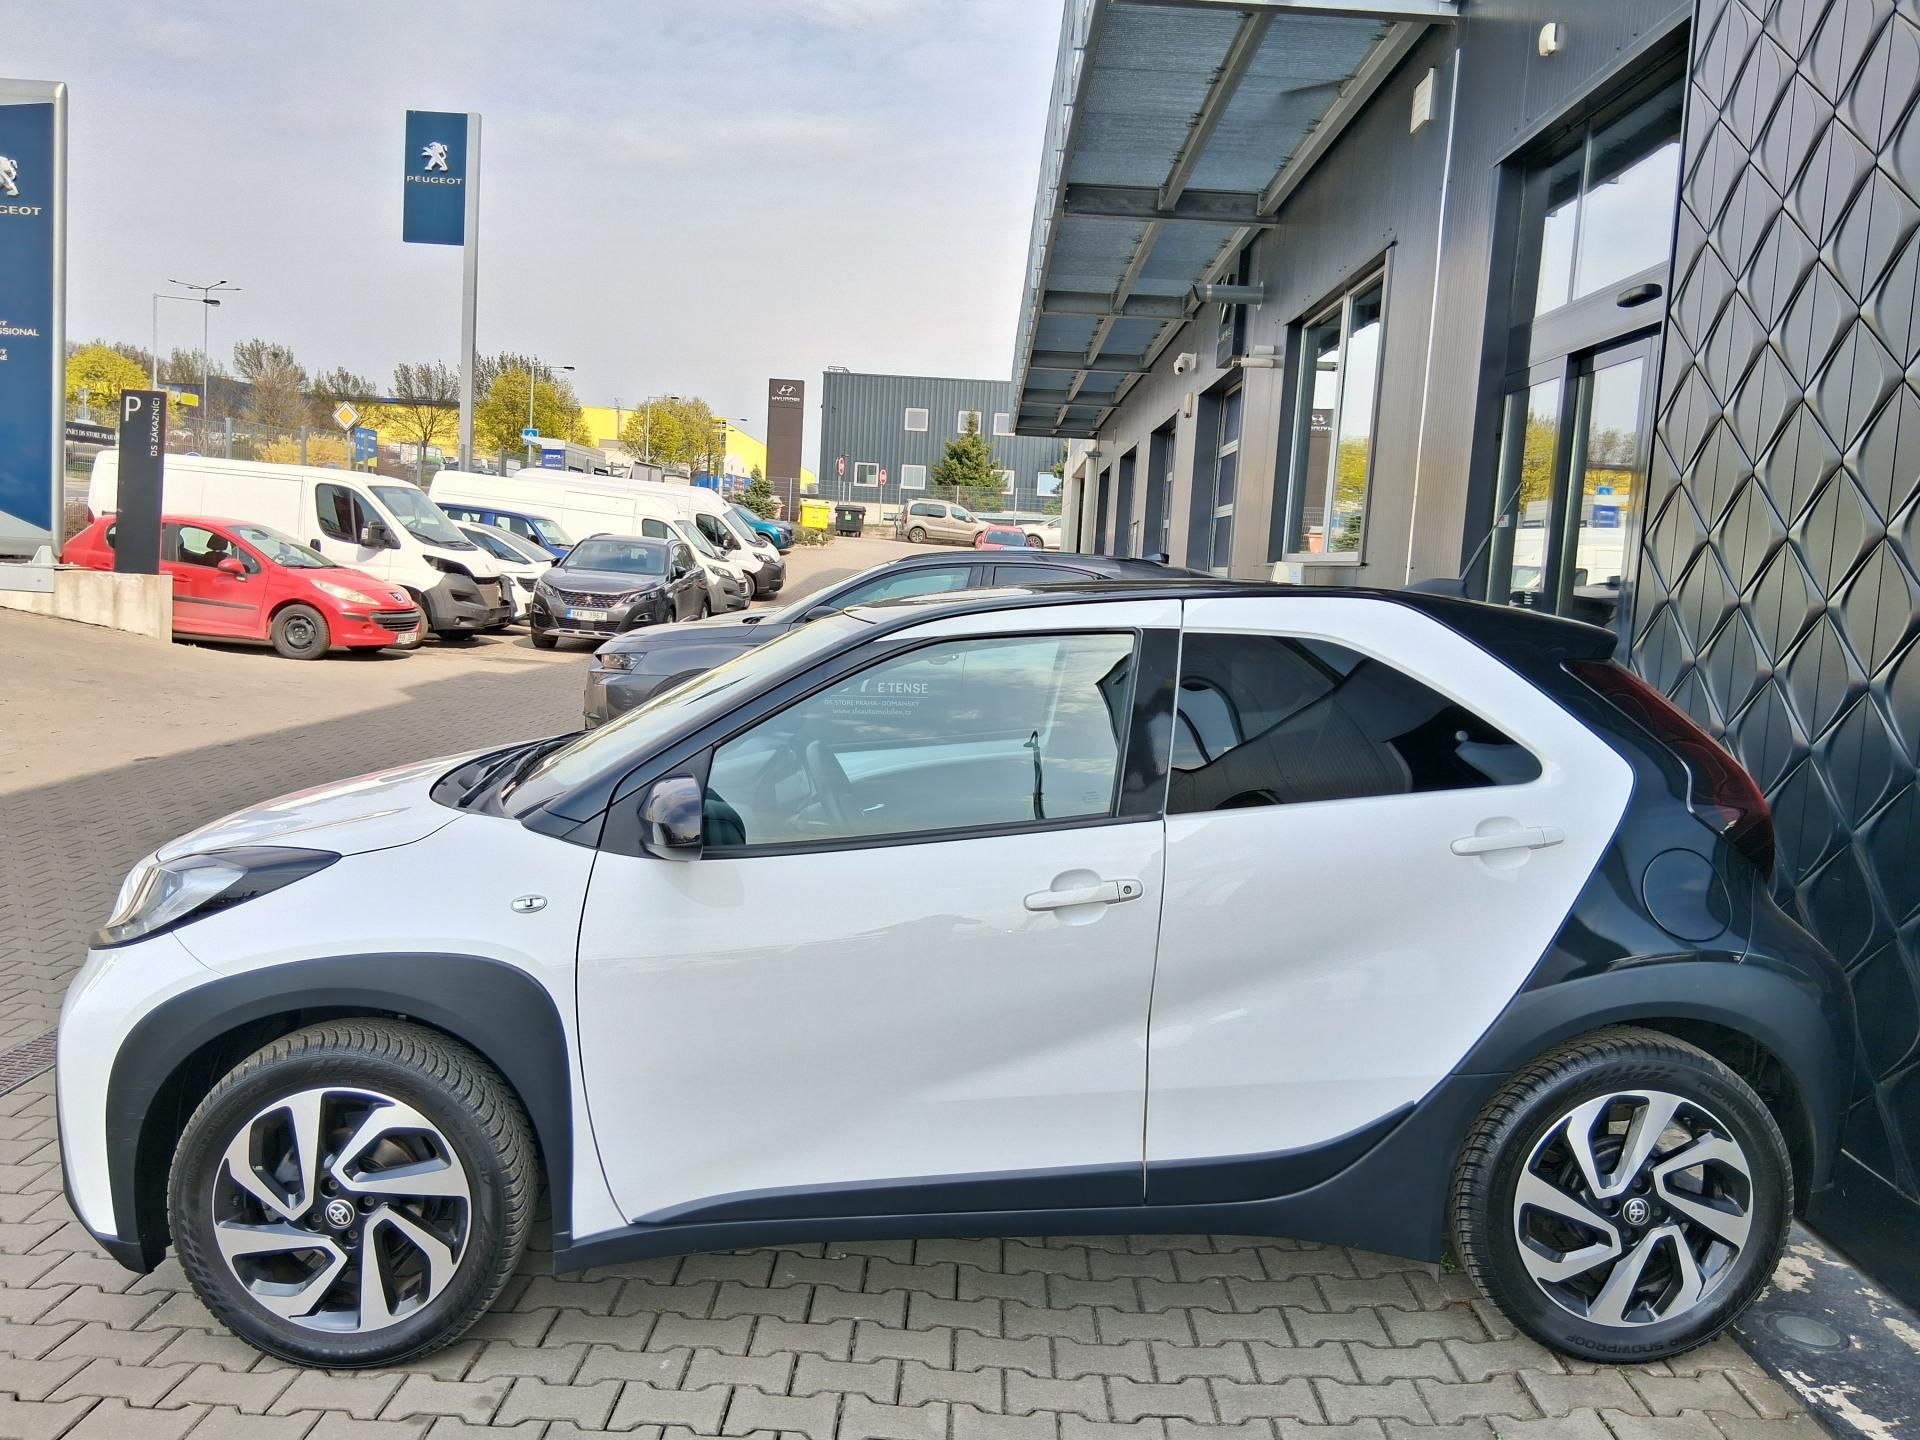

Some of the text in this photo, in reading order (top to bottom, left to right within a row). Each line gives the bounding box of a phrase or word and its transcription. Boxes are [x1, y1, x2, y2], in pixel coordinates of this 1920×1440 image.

[406, 175, 463, 185] PEUGEOT
[125, 396, 142, 422] P
[150, 397, 160, 457] DS ZÁKAZNÍCI
